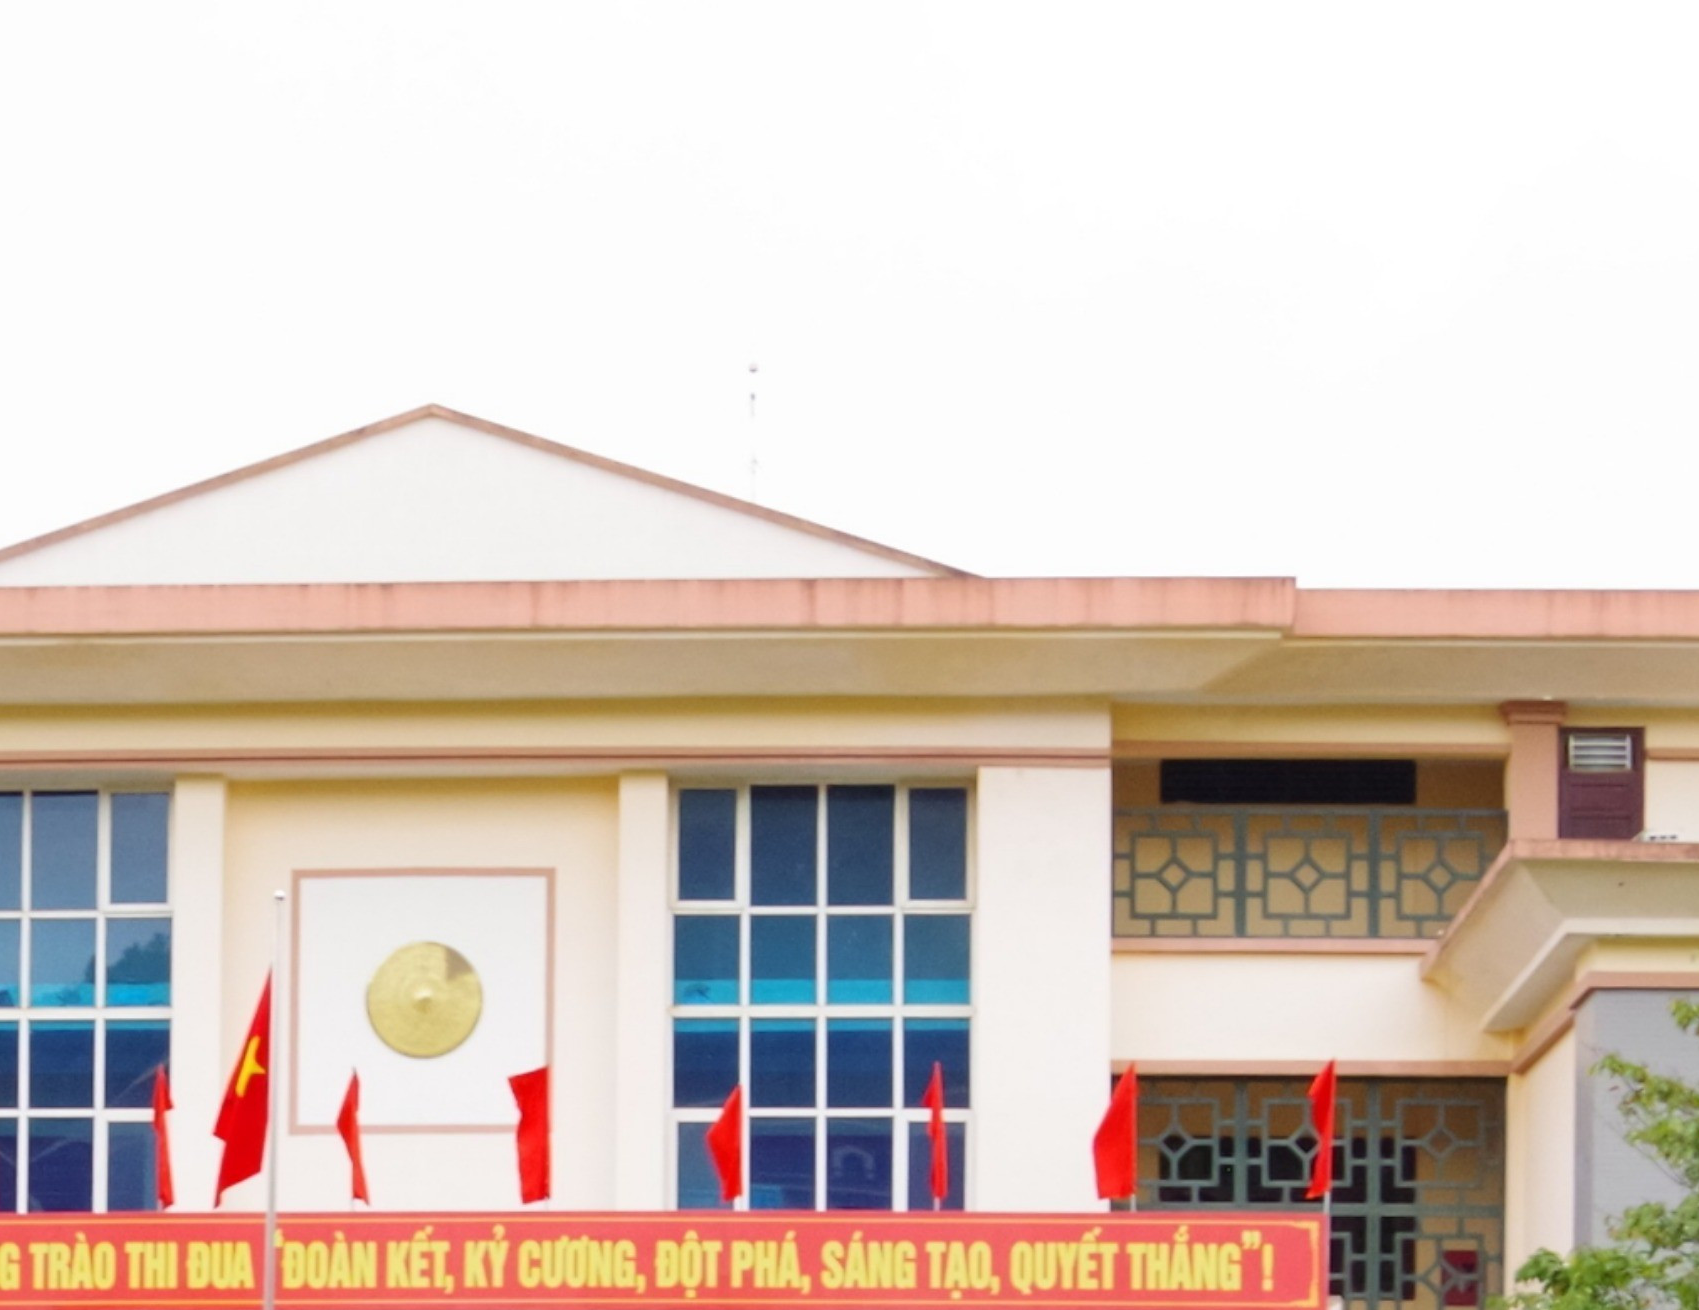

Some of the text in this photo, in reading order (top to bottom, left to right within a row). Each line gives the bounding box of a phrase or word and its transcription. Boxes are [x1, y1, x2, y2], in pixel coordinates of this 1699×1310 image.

[28, 1231, 116, 1290] TRÀO
[125, 1241, 178, 1289] THI
[186, 1240, 255, 1289] ĐUA
[386, 1225, 455, 1294] KẾT,
[464, 1224, 509, 1289] KỶ
[518, 1235, 646, 1294] CƯƠNG,
[655, 1230, 722, 1298] ĐỘT
[731, 1230, 812, 1294] PHÁ,
[821, 1231, 917, 1289] SÁNG
[926, 1241, 1001, 1299] TẠO,
[1010, 1226, 1120, 1295] QUYẾT
